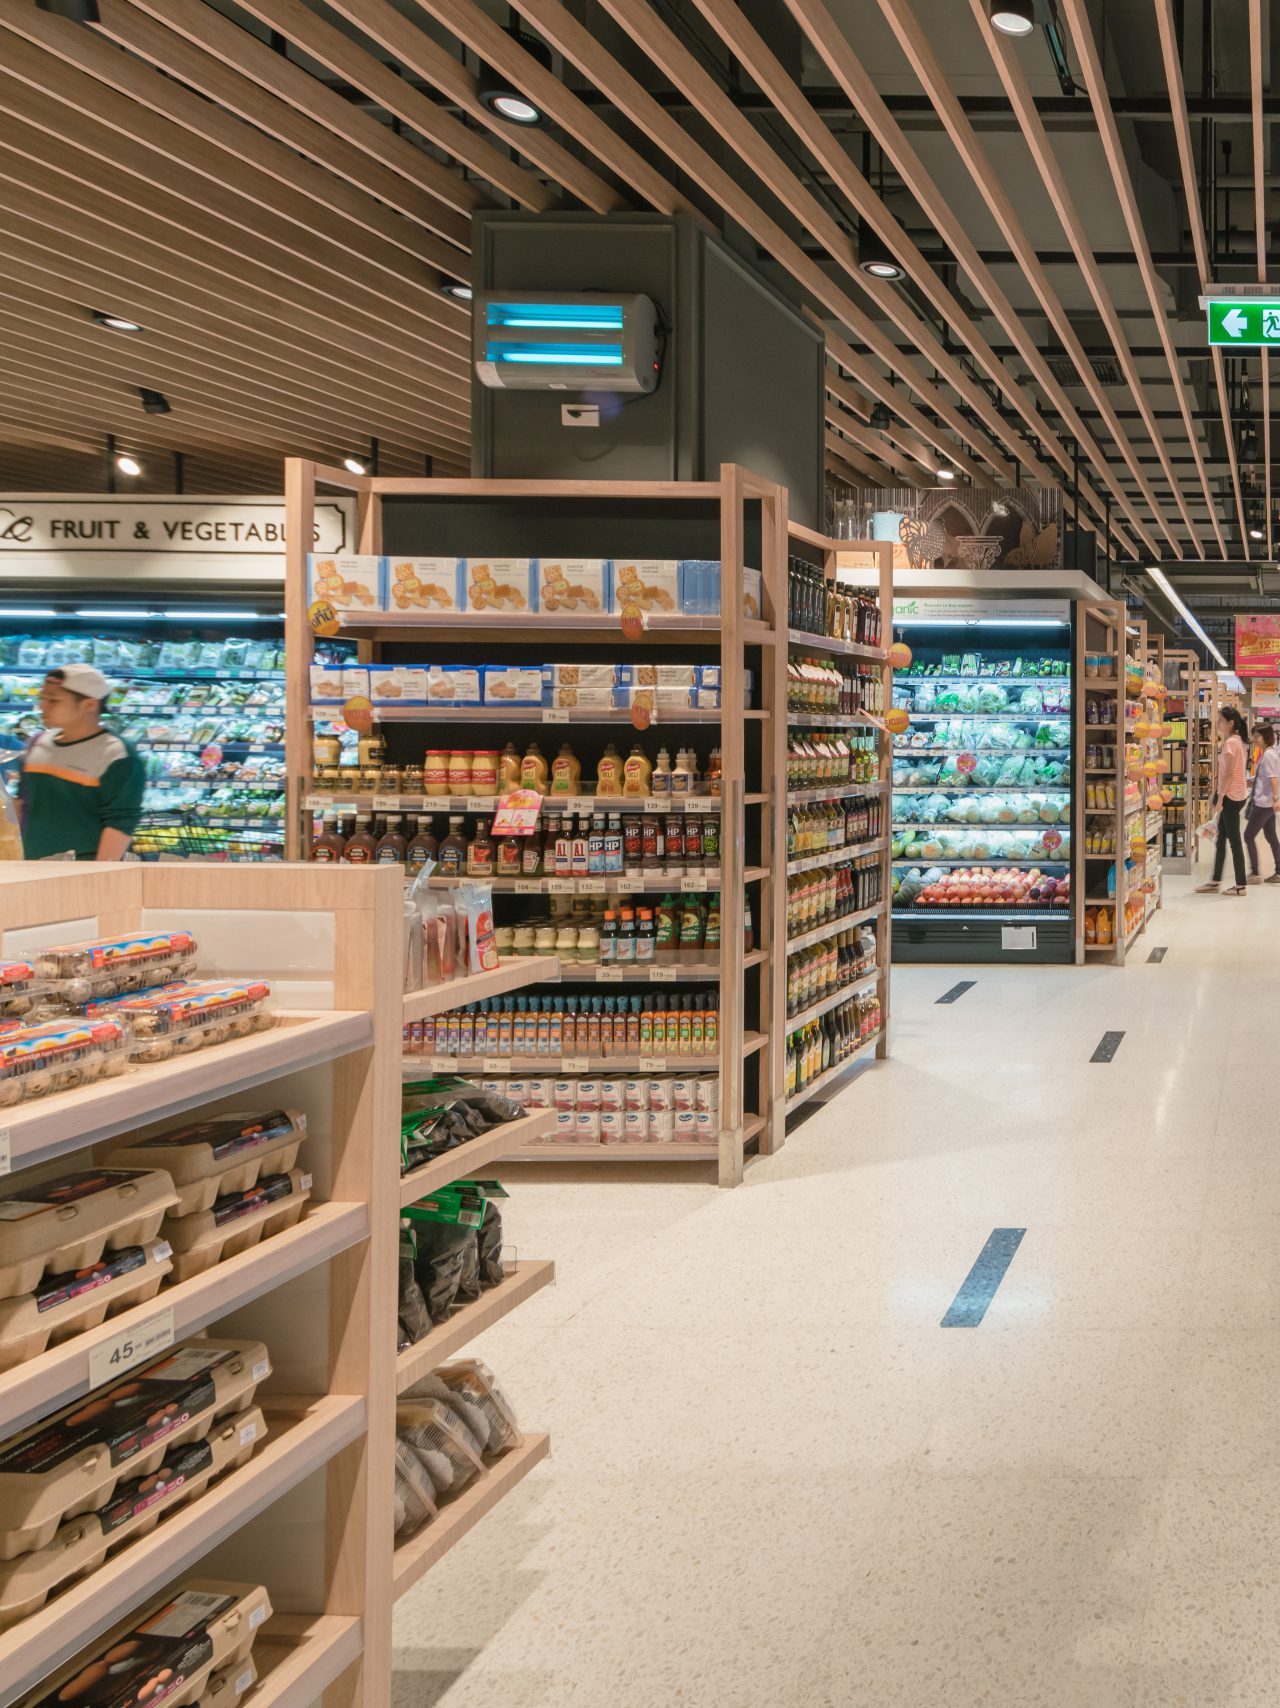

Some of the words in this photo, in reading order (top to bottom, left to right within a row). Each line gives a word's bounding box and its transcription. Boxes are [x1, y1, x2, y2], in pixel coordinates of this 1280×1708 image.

[50, 520, 120, 539] FRUIT
[133, 521, 150, 539] &
[163, 521, 321, 542] VEGETABLS
[626, 828, 639, 837] HP
[643, 828, 655, 837] HP
[667, 828, 680, 836] HP
[686, 827, 699, 836] HP
[704, 828, 717, 836] HP
[589, 841, 603, 851] HP
[605, 841, 620, 851] HP
[13, 1051, 41, 1064] Partridge
[109, 1341, 133, 1364] 45
